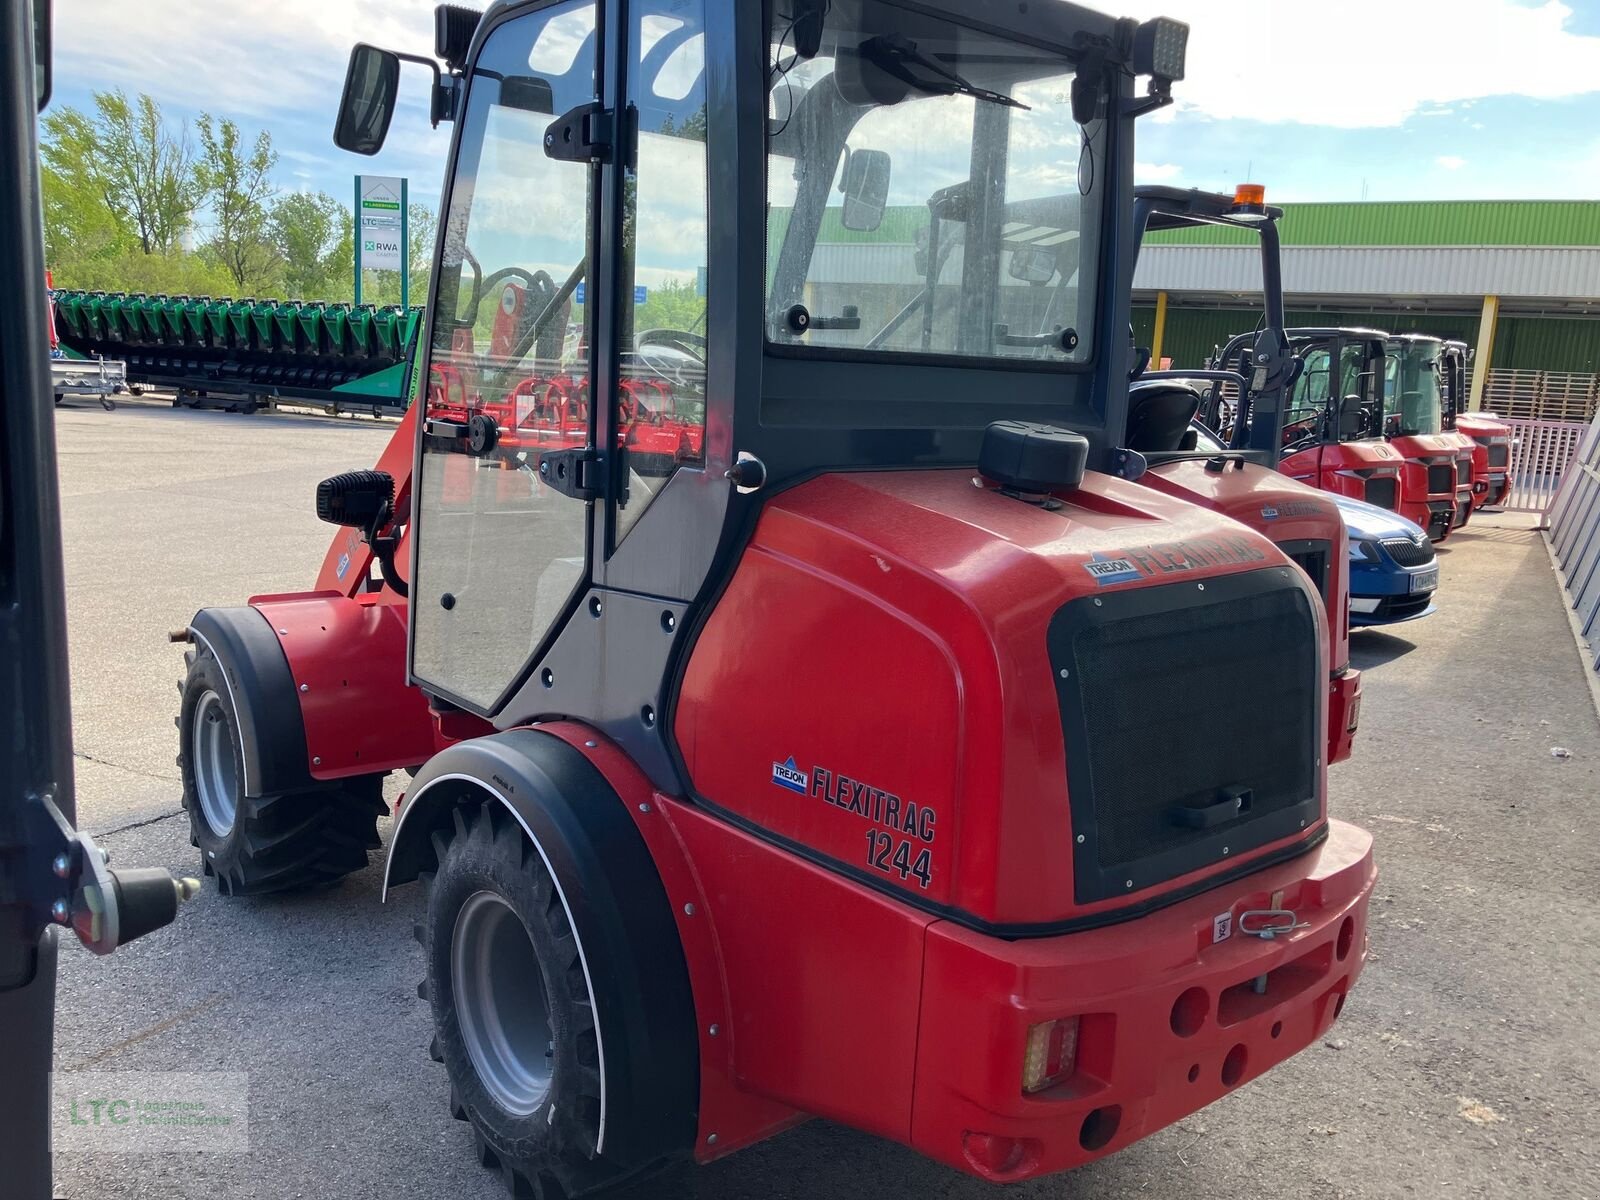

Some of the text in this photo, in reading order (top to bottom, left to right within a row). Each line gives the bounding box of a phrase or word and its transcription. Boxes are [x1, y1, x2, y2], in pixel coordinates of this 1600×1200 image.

[362, 218, 377, 226] LTC
[376, 242, 398, 251] RWA
[1087, 535, 1265, 576] TREJON FLEXITRAC
[774, 765, 936, 844] TREJON FLEXITRAC
[866, 828, 932, 889] 1244
